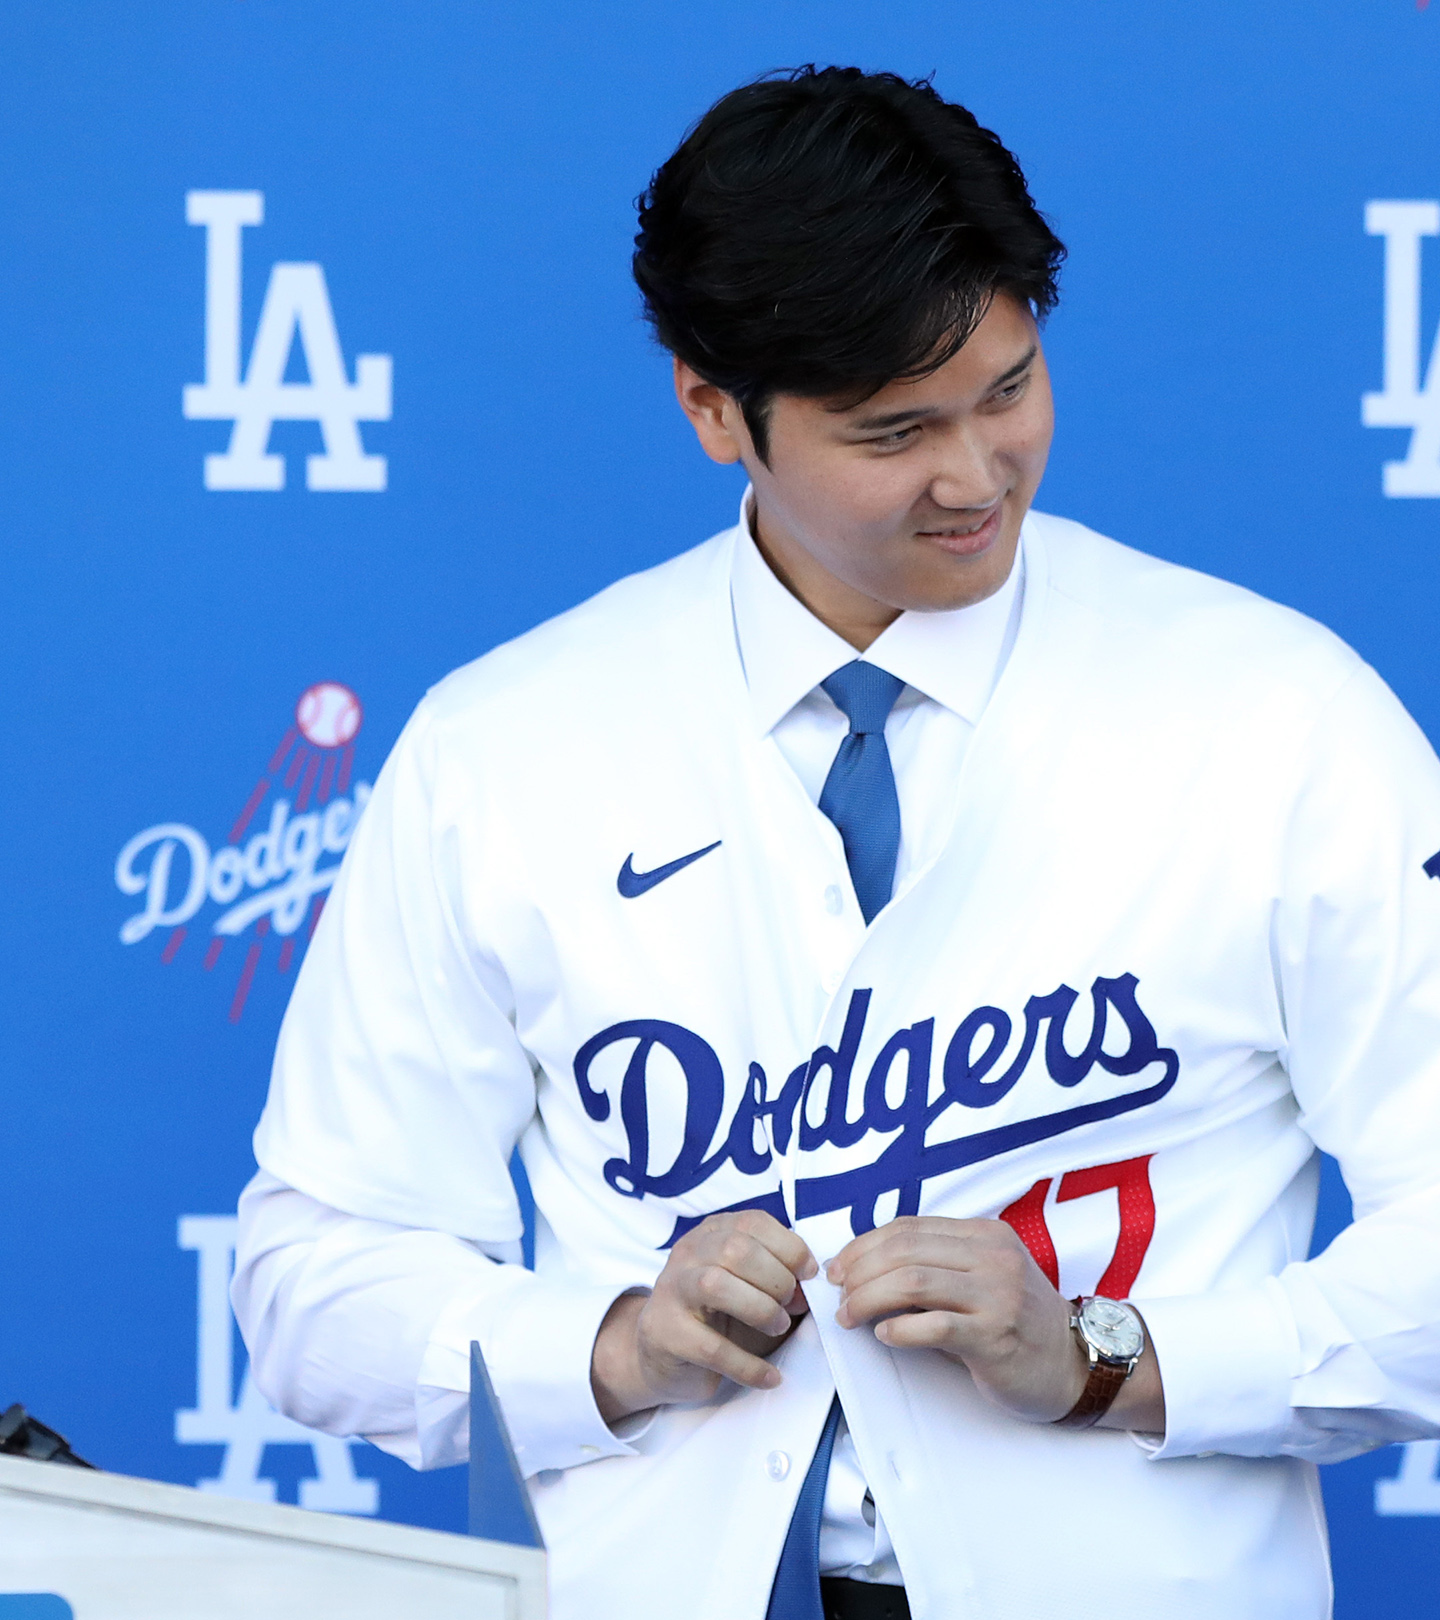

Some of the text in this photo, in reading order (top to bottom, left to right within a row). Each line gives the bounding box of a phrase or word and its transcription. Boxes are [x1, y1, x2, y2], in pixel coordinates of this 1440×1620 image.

[184, 190, 393, 492] LA
[115, 781, 373, 945] Dodge
[573, 972, 1180, 1250] Dodgers
[999, 1153, 1157, 1300] 17
